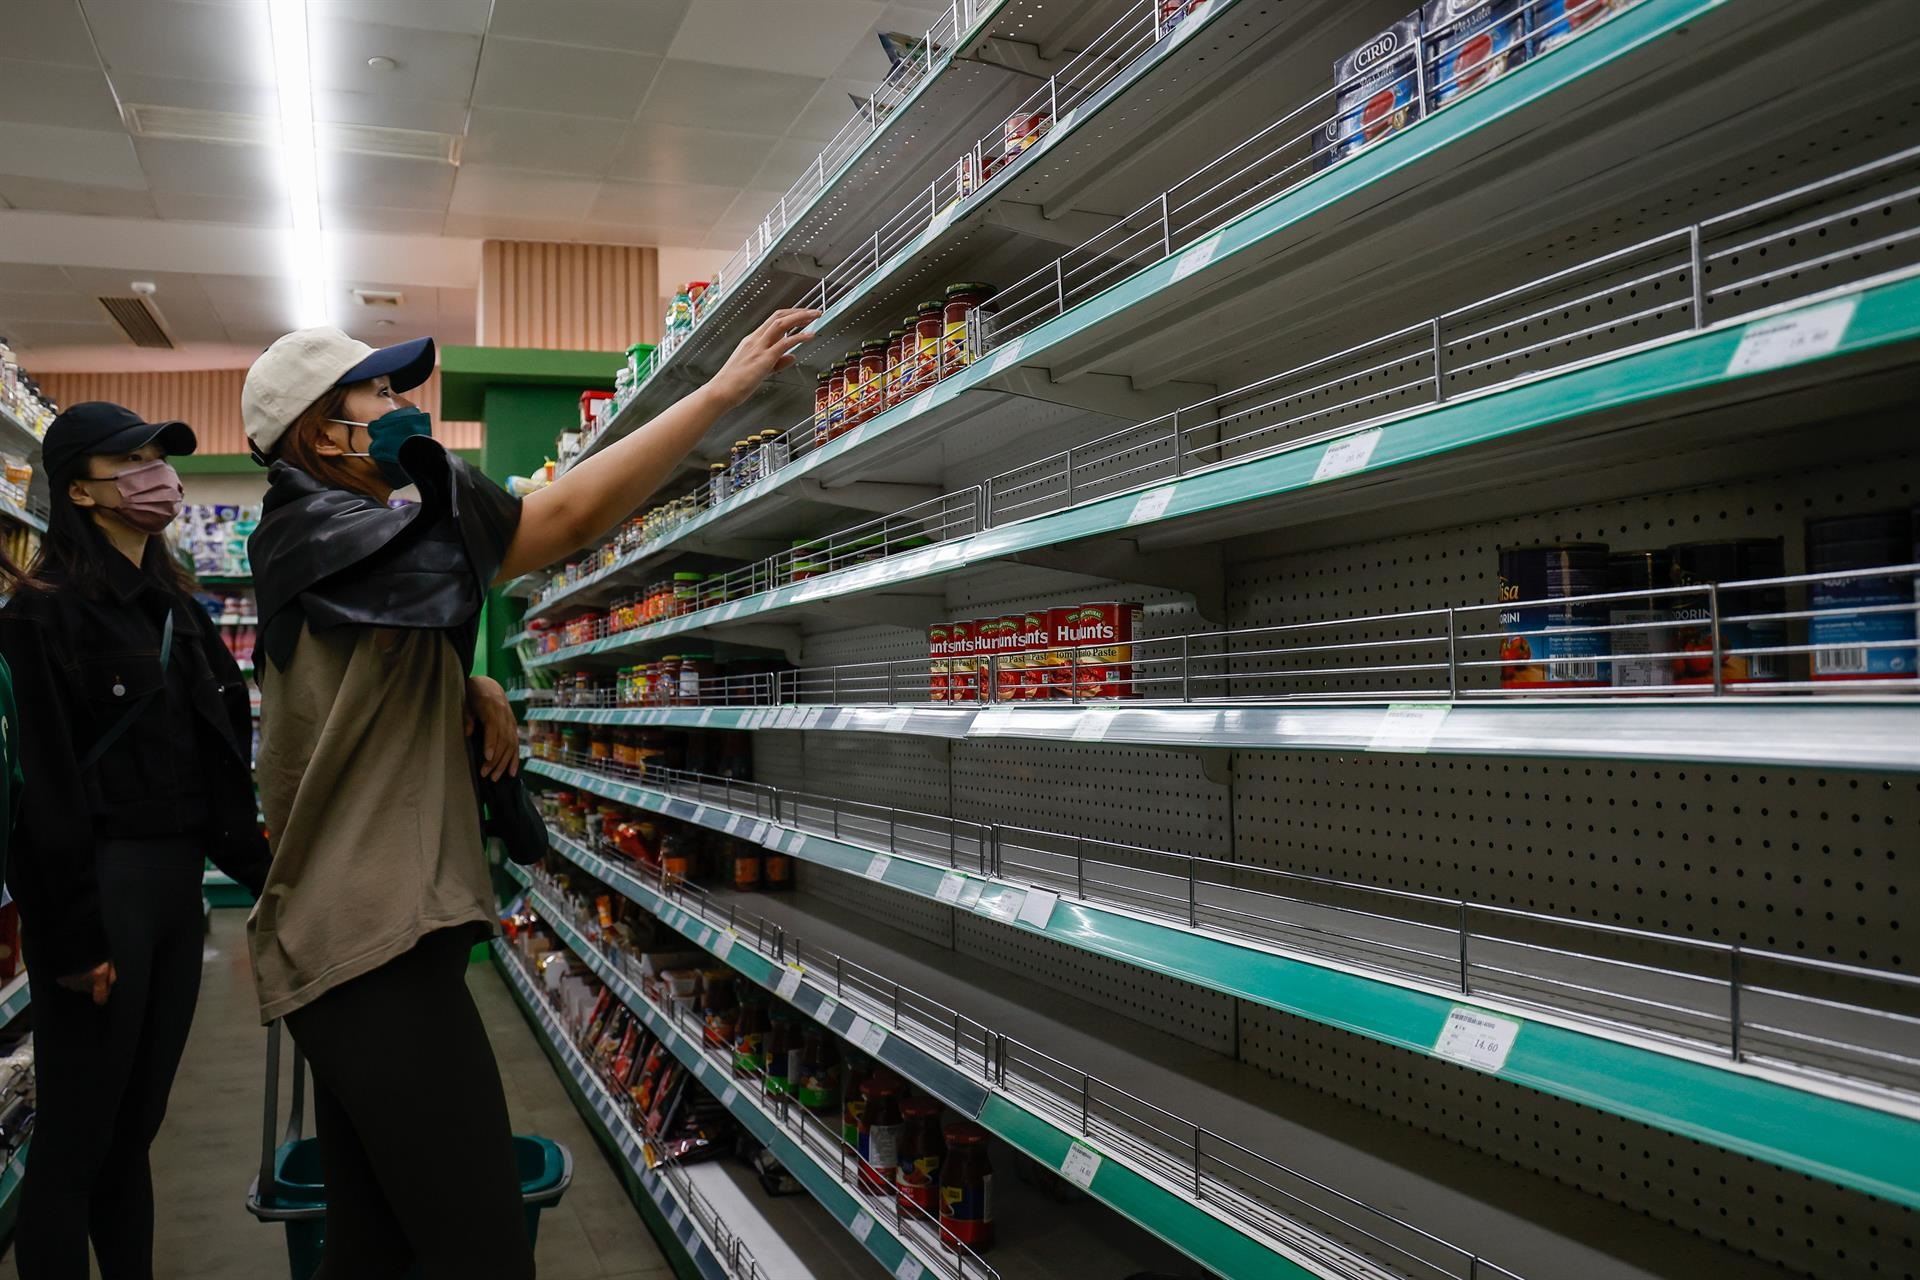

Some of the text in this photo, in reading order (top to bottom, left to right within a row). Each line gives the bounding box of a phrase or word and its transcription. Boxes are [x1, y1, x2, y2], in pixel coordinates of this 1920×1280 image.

[1358, 37, 1393, 66] CIRIO
[1500, 582, 1519, 601] isa
[1499, 611, 1520, 625] ORINI
[1474, 1039, 1499, 1053] 14.60
